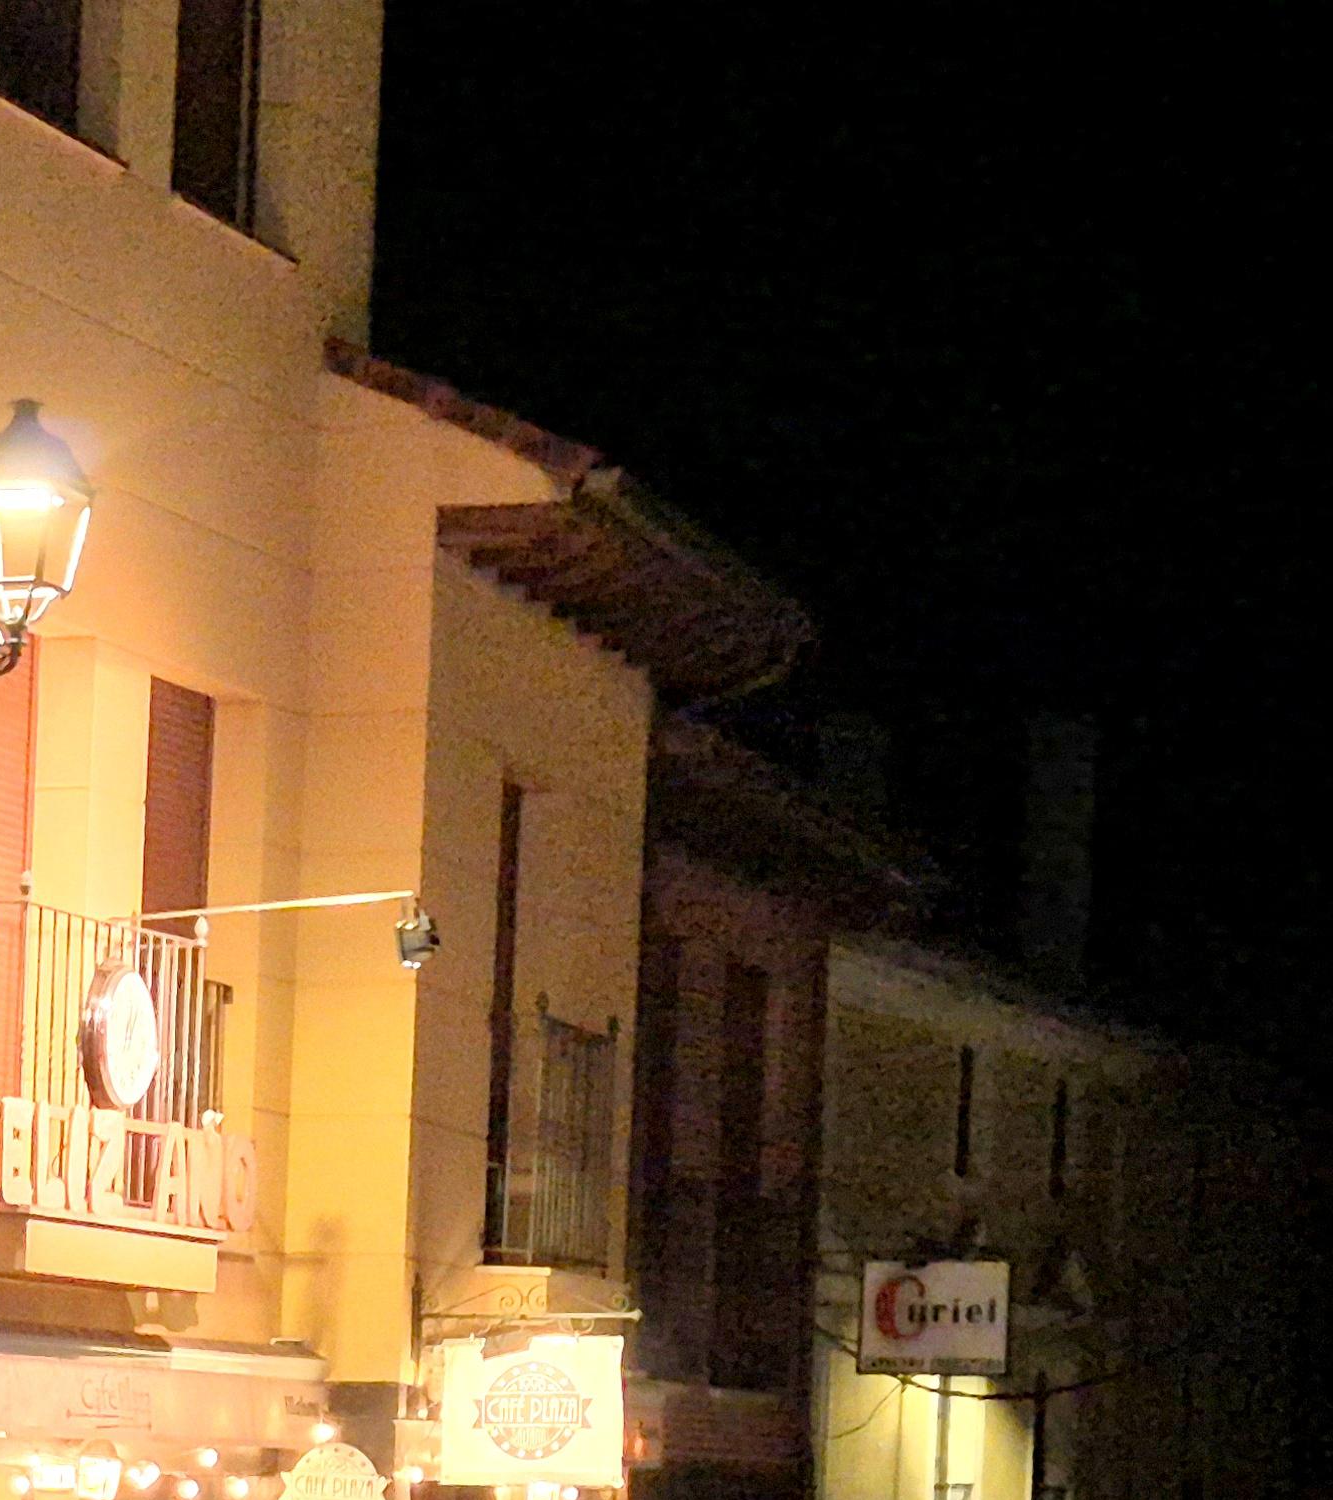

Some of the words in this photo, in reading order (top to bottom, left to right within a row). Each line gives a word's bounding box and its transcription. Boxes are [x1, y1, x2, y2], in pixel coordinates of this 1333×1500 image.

[875, 1274, 996, 1342] Curiel
[486, 1392, 526, 1424] CAFÉ
[529, 1396, 578, 1424] PLAZA
